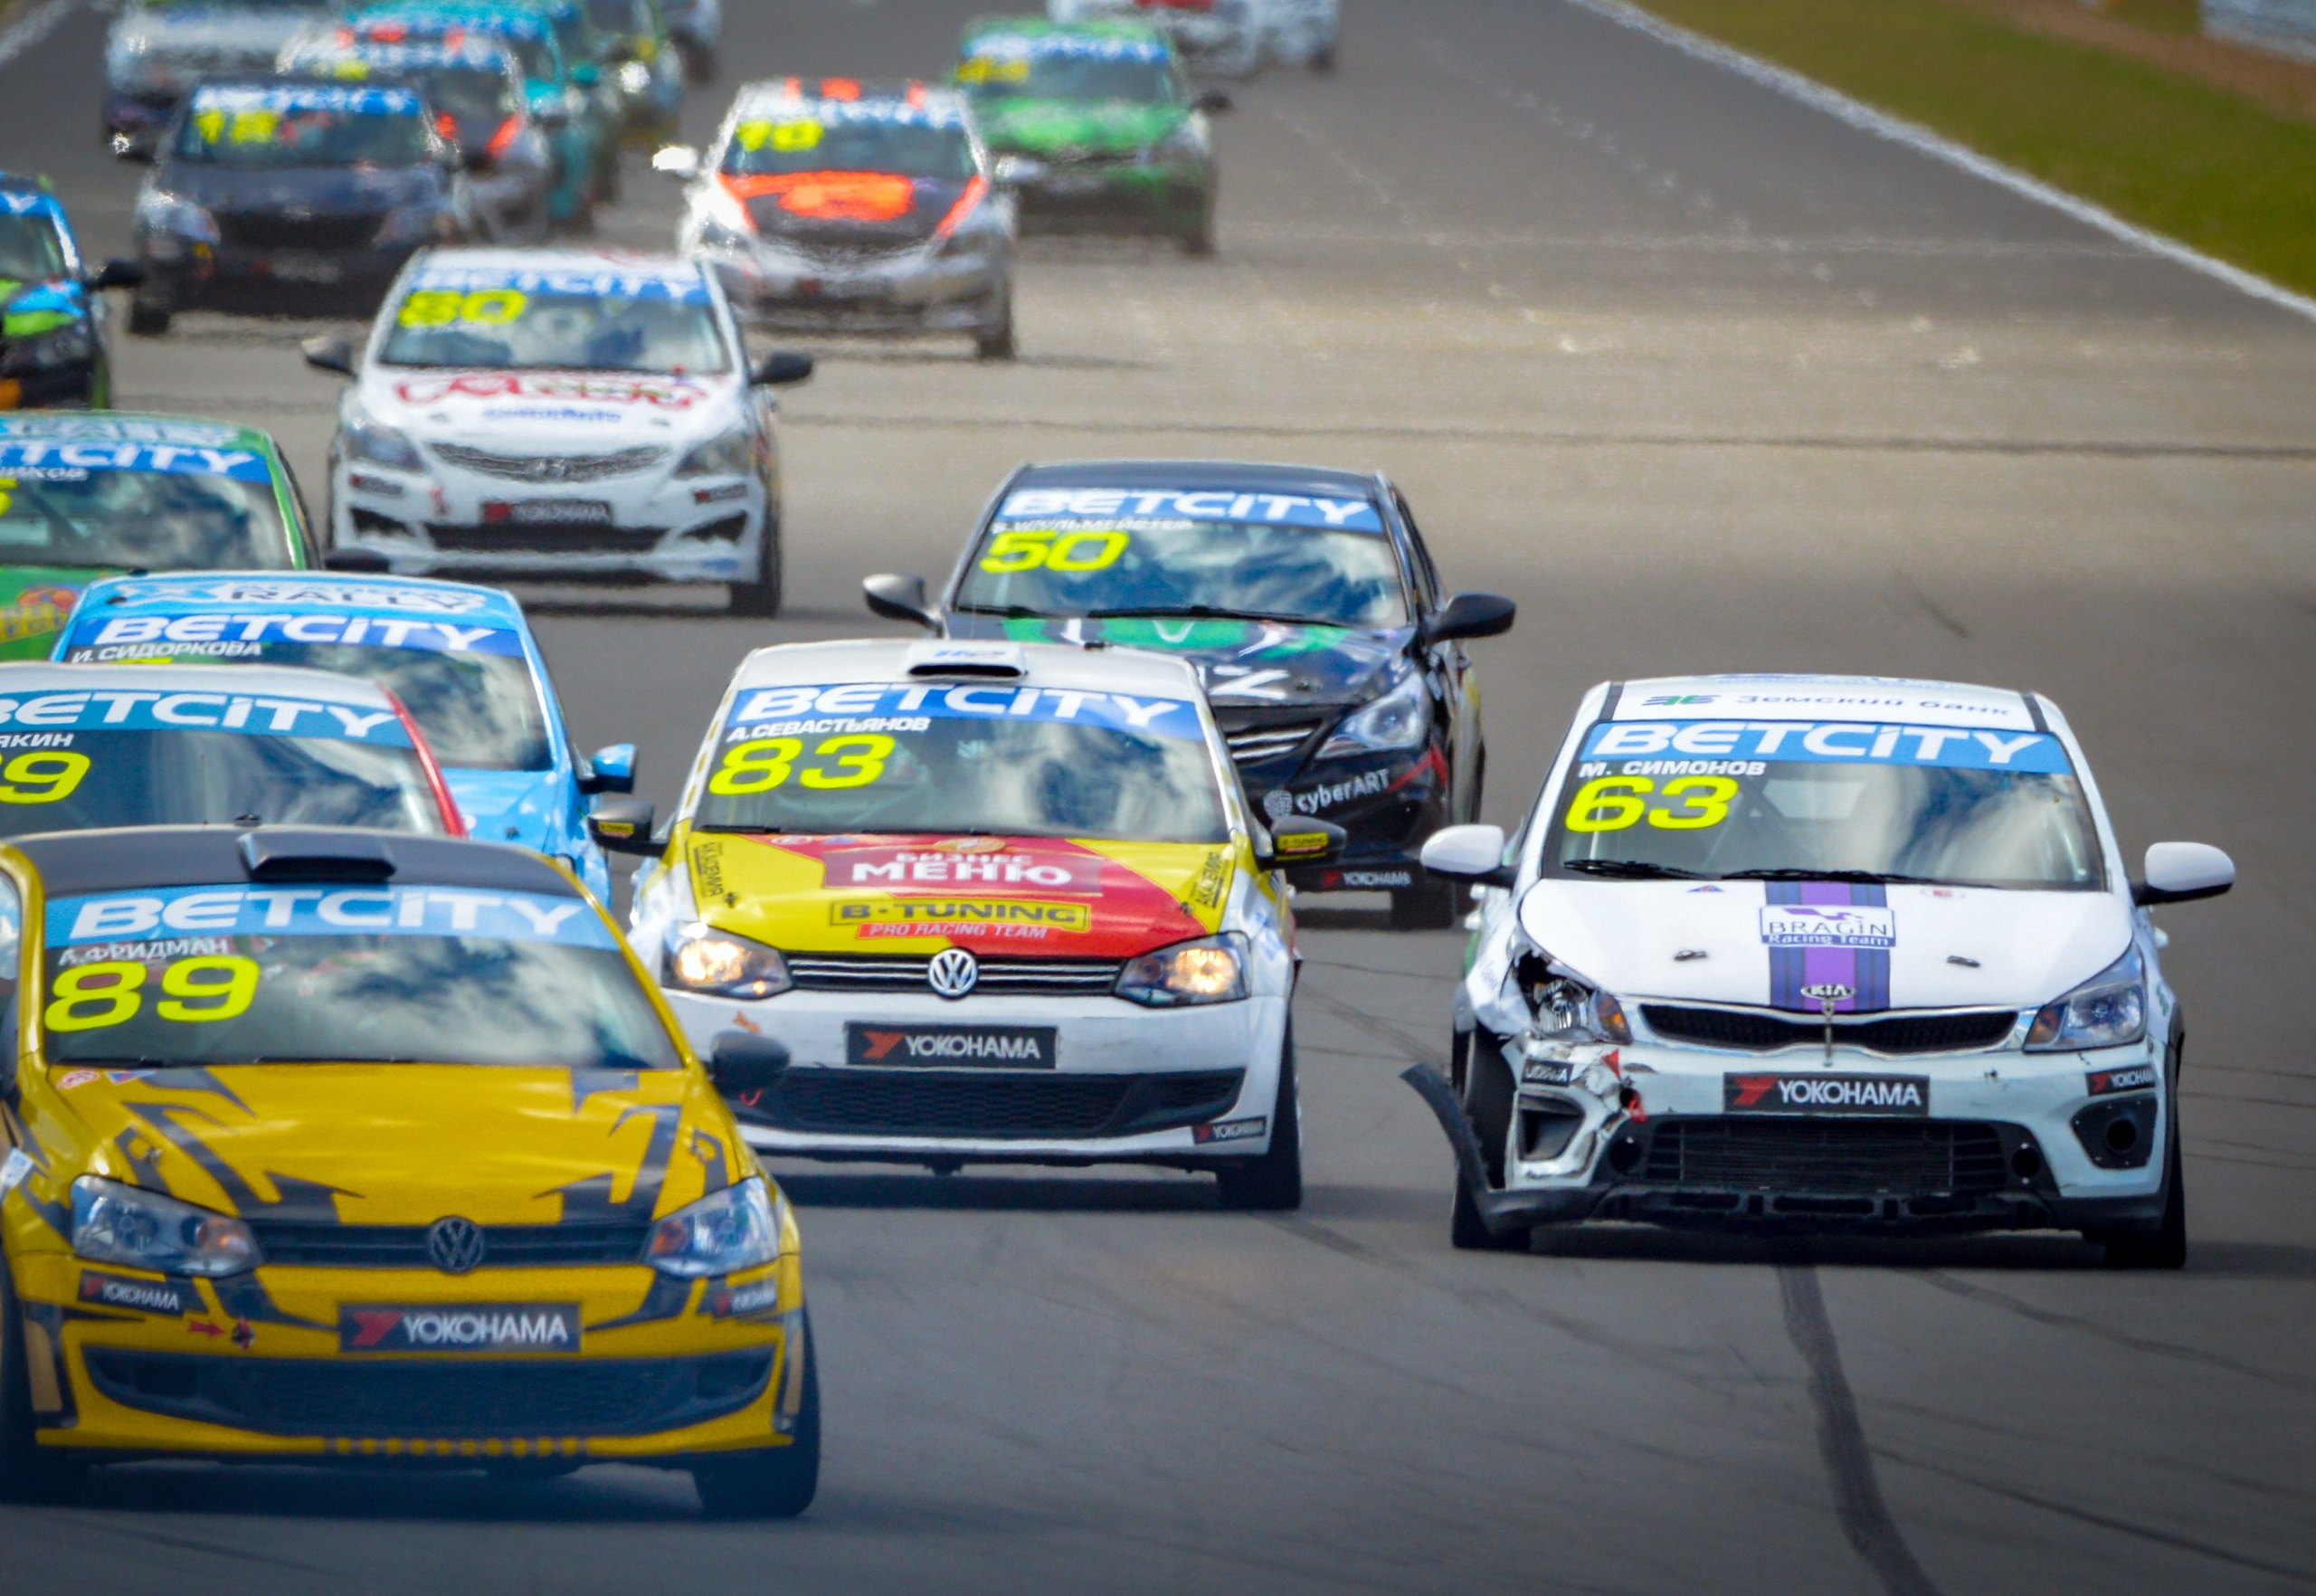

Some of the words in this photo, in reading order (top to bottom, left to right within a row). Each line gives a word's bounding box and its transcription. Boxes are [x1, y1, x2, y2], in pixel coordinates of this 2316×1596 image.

[1003, 489, 1369, 524] BETCITY
[980, 530, 1129, 573] 50
[94, 615, 497, 651] BETCITY
[98, 641, 262, 660] СИДОРКОВА
[0, 692, 398, 737] ETCITY
[736, 685, 1182, 727] BETCITY
[1736, 694, 1903, 708] Земский
[1919, 700, 2010, 717] банк
[1592, 723, 2045, 765] BETCITY
[0, 751, 91, 804] 9
[708, 734, 896, 795] 83
[1578, 762, 1612, 778] М.
[1622, 760, 1767, 776] СИМОНОВ
[1296, 769, 1390, 813] cyberART
[1564, 775, 1739, 832] 63
[852, 862, 1072, 886] МЕНЮ
[71, 891, 584, 937] BETCITY
[869, 923, 909, 936] PRO
[915, 923, 987, 936] RACING
[994, 925, 1048, 938] TEAM
[1767, 935, 1833, 945] Racing
[1838, 935, 1889, 946] Team
[43, 955, 261, 1032] 89
[1811, 983, 1846, 996] KIA
[906, 1034, 1041, 1059] YOKOHAMA
[1779, 1079, 1921, 1107] YOKOHAMA
[101, 1283, 179, 1310] YOKOHAMA
[402, 1313, 568, 1344] YOKOHAMA
